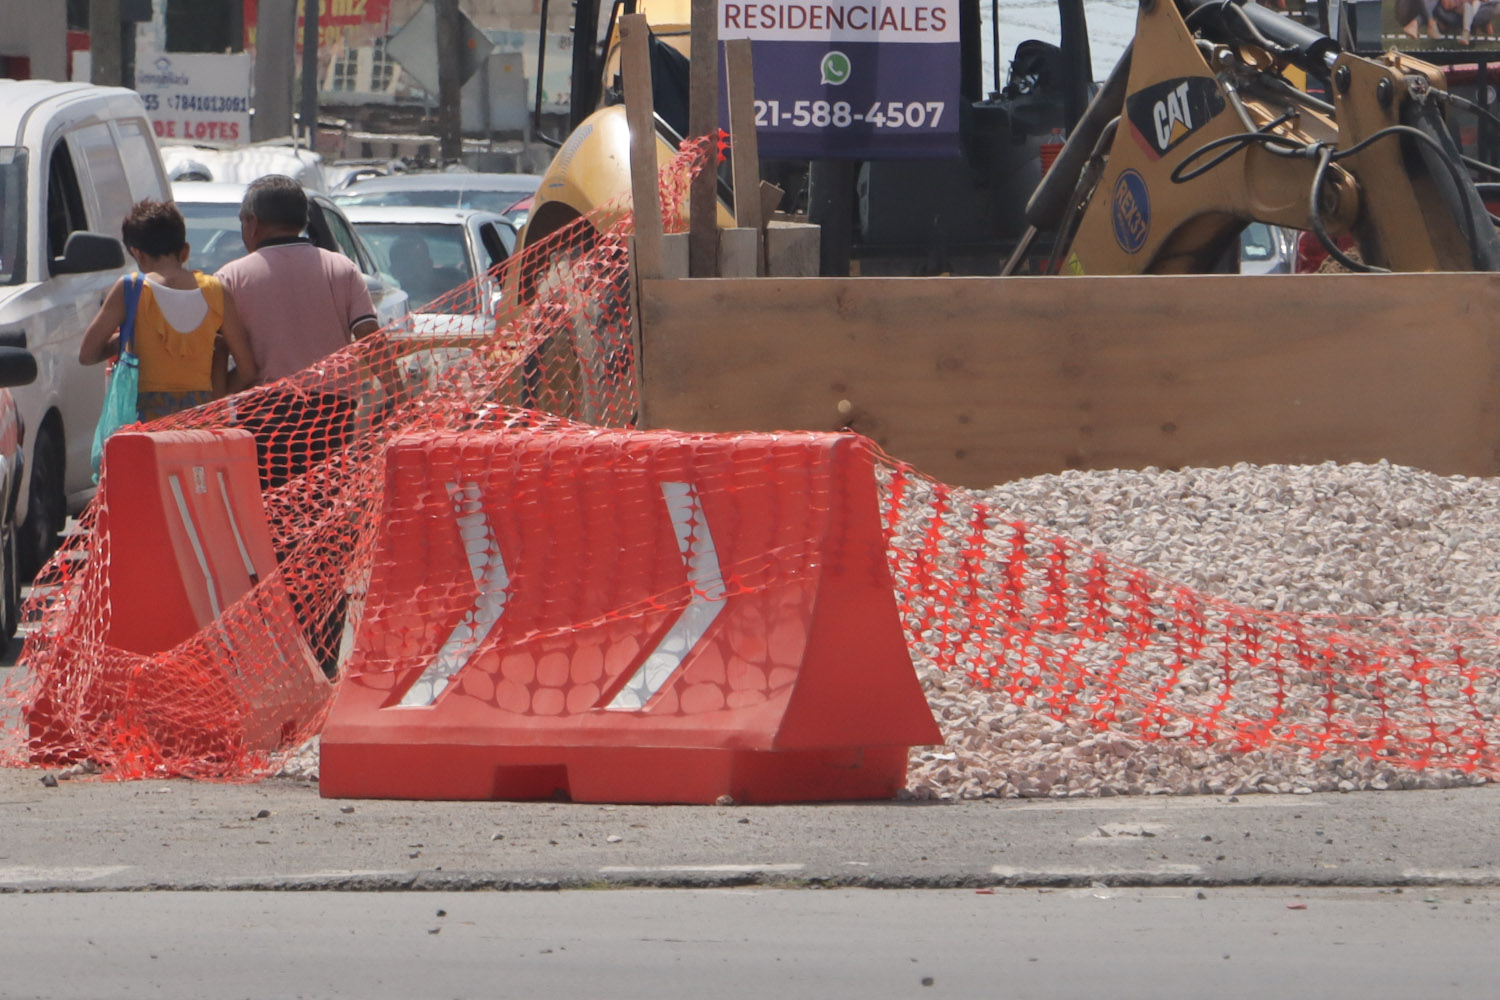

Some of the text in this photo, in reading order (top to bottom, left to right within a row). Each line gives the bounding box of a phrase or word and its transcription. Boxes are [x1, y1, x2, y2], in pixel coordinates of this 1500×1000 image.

[725, 3, 947, 32] RESIDENCIALES
[153, 120, 240, 140] DE LOTES
[1153, 81, 1193, 150] CAT
